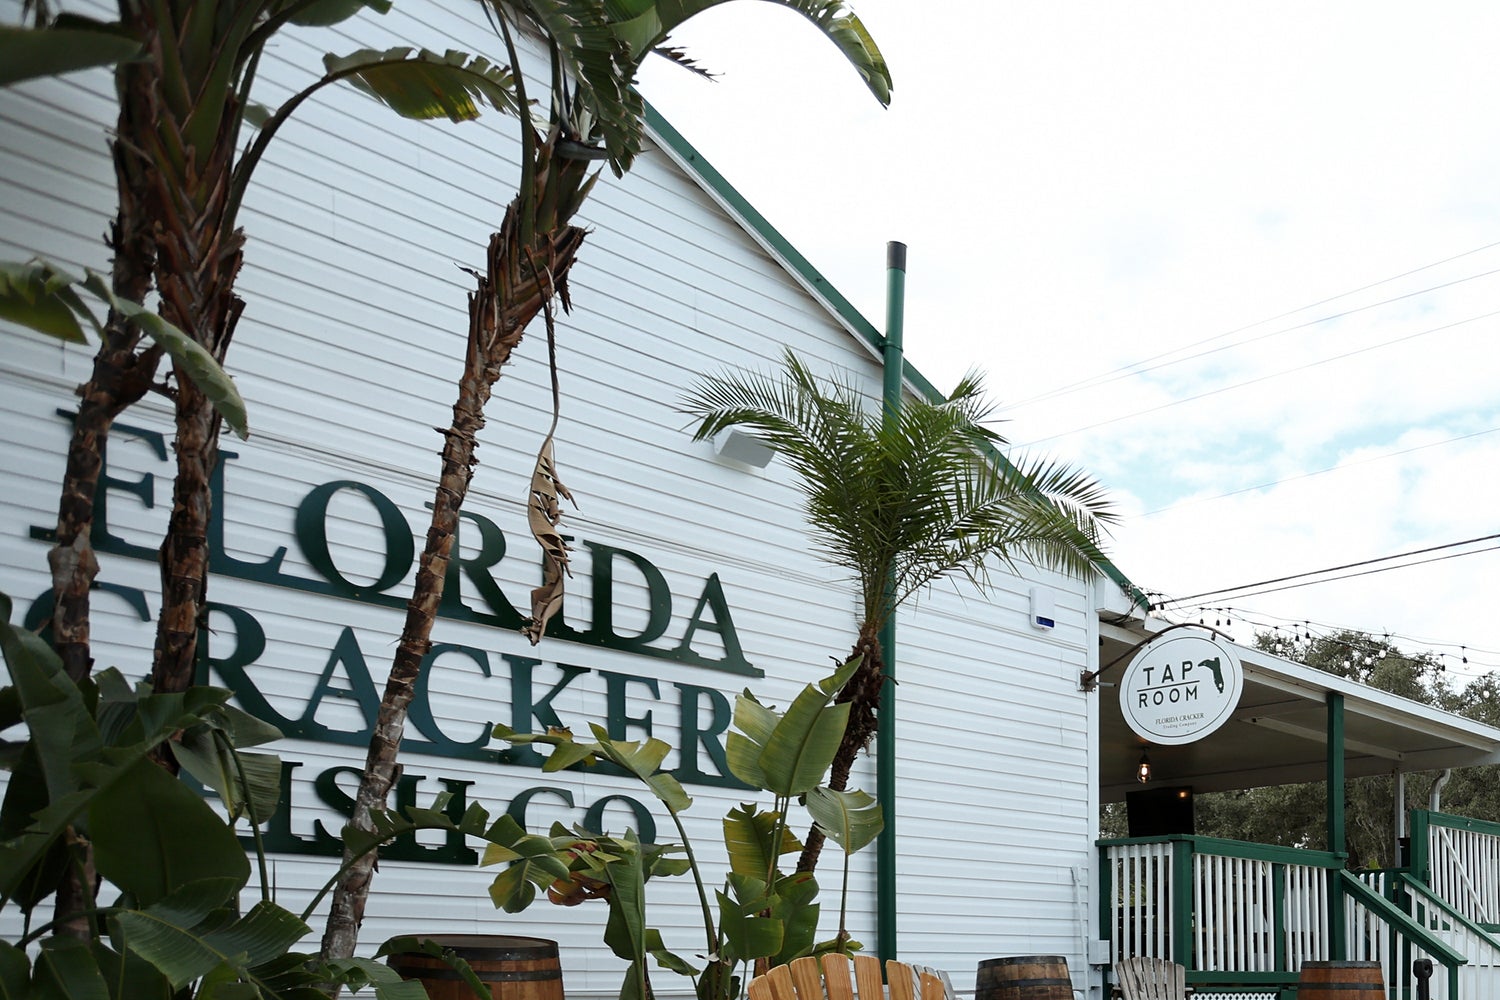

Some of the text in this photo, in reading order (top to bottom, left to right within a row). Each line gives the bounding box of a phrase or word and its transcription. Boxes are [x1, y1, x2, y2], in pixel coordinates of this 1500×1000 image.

[1143, 660, 1193, 686] TAP
[1138, 686, 1198, 708] ROOM
[1155, 712, 1205, 725] FLORIDA CRACKER
